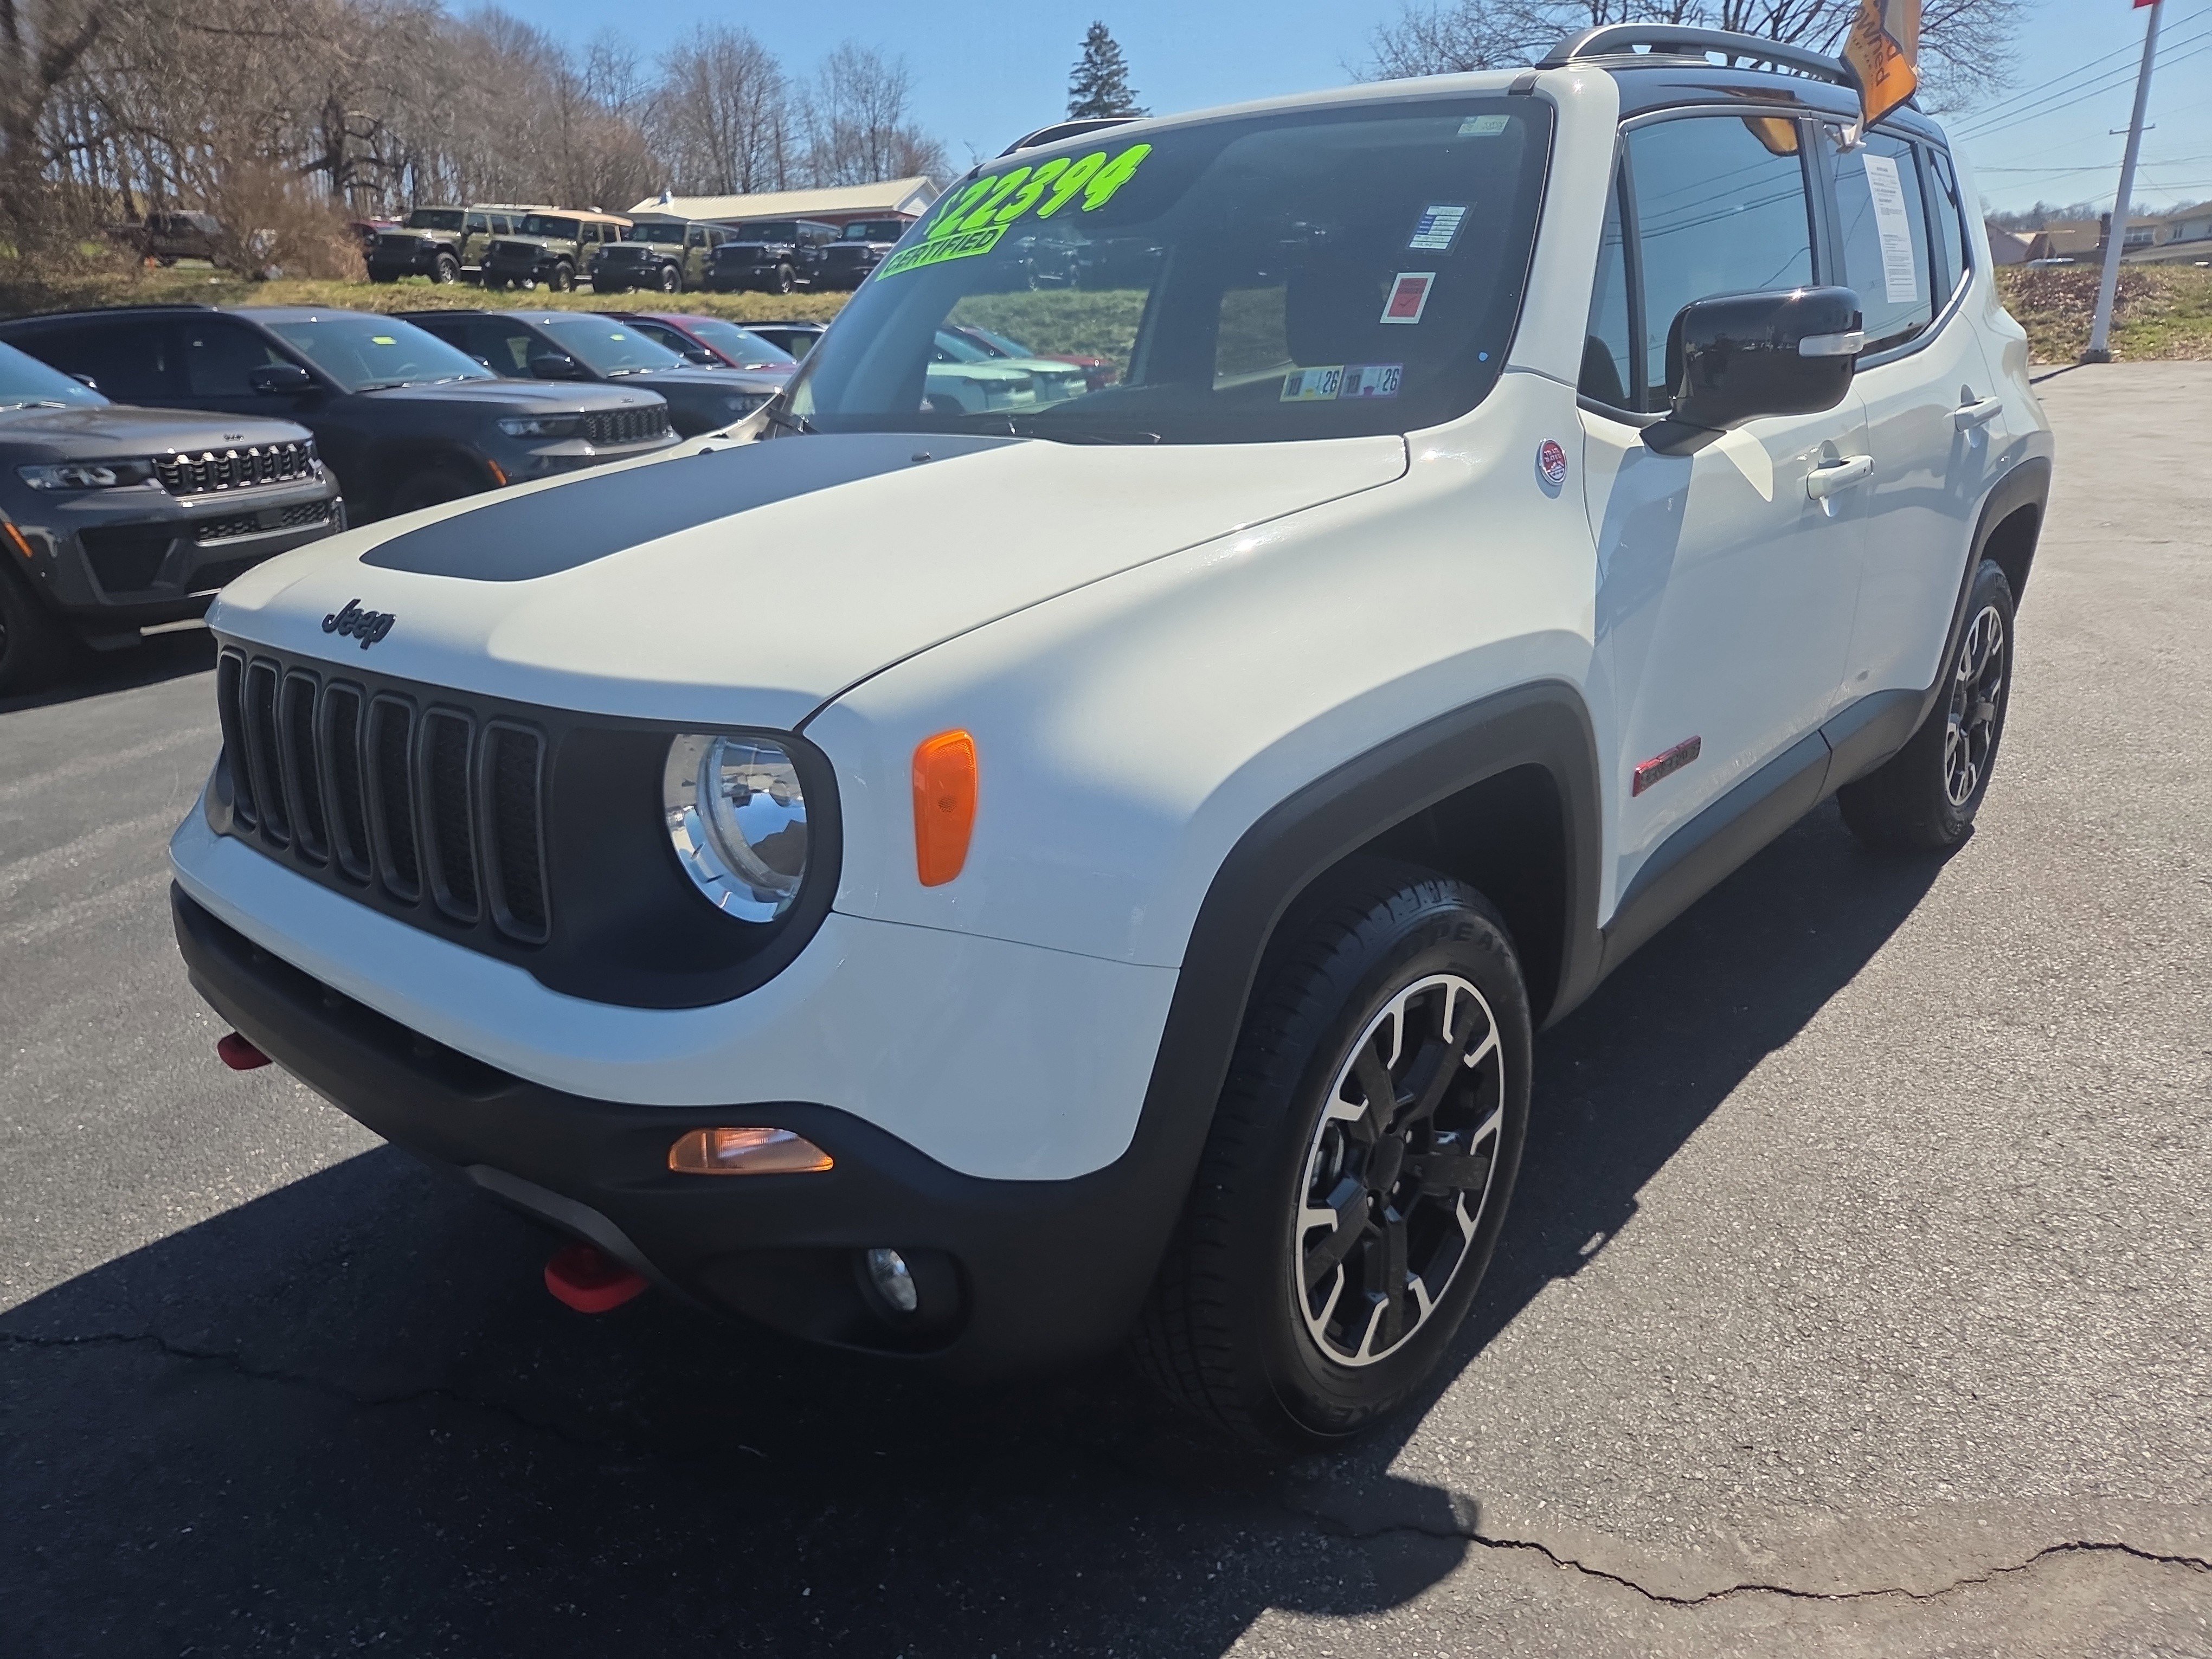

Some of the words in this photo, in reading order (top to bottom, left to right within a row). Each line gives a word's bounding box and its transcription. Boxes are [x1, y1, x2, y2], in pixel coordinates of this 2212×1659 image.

[885, 230, 1002, 272] CERTIFIED
[1322, 370, 1340, 393] 26
[1382, 368, 1400, 392] 26
[321, 598, 397, 651] Jeep
